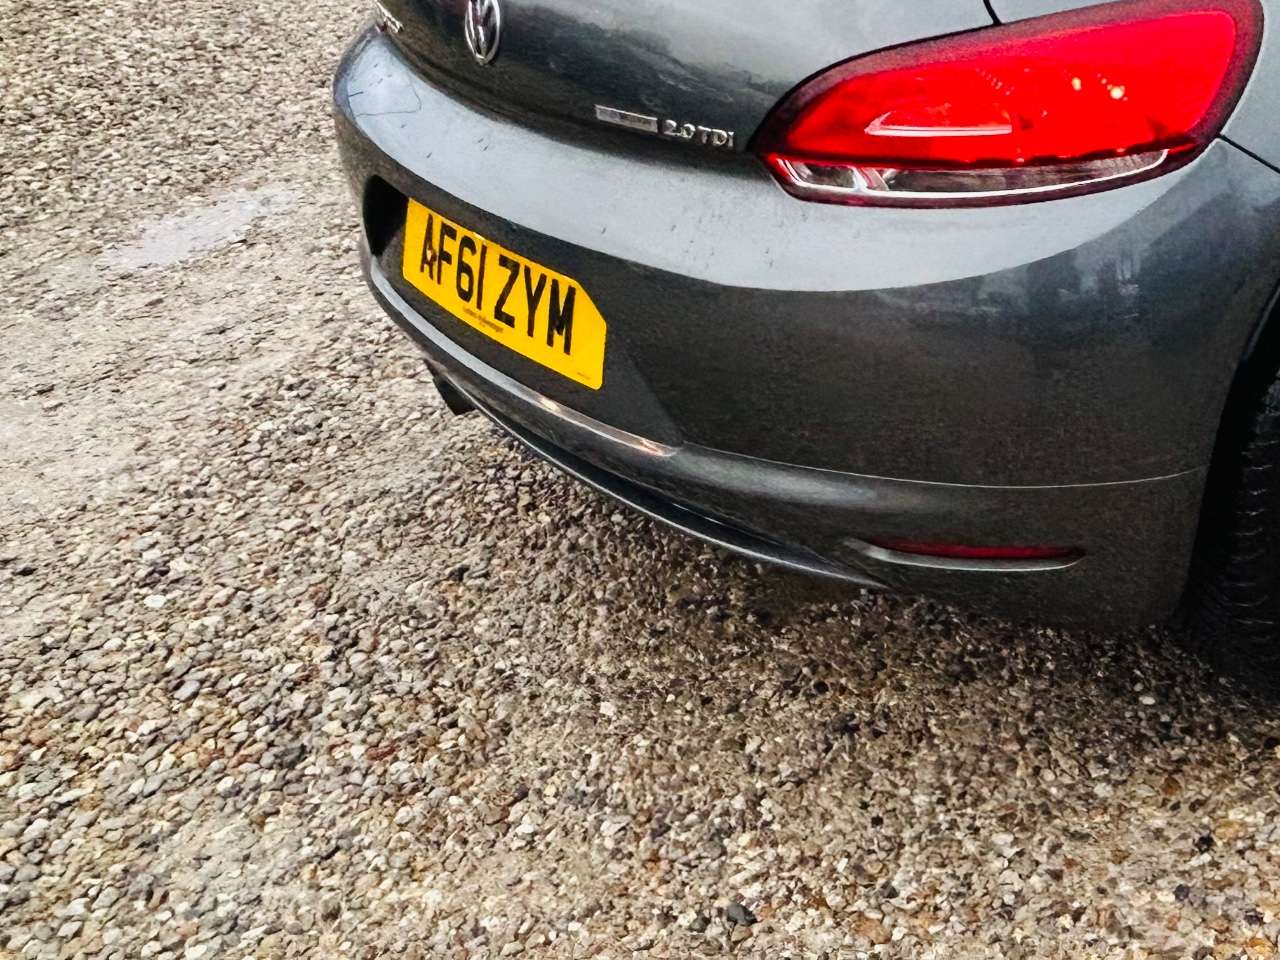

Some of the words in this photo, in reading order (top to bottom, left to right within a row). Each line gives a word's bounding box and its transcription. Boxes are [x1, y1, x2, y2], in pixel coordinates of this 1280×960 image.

[697, 125, 735, 147] TDI
[419, 213, 488, 311] AF61
[493, 253, 577, 356] ZYM
